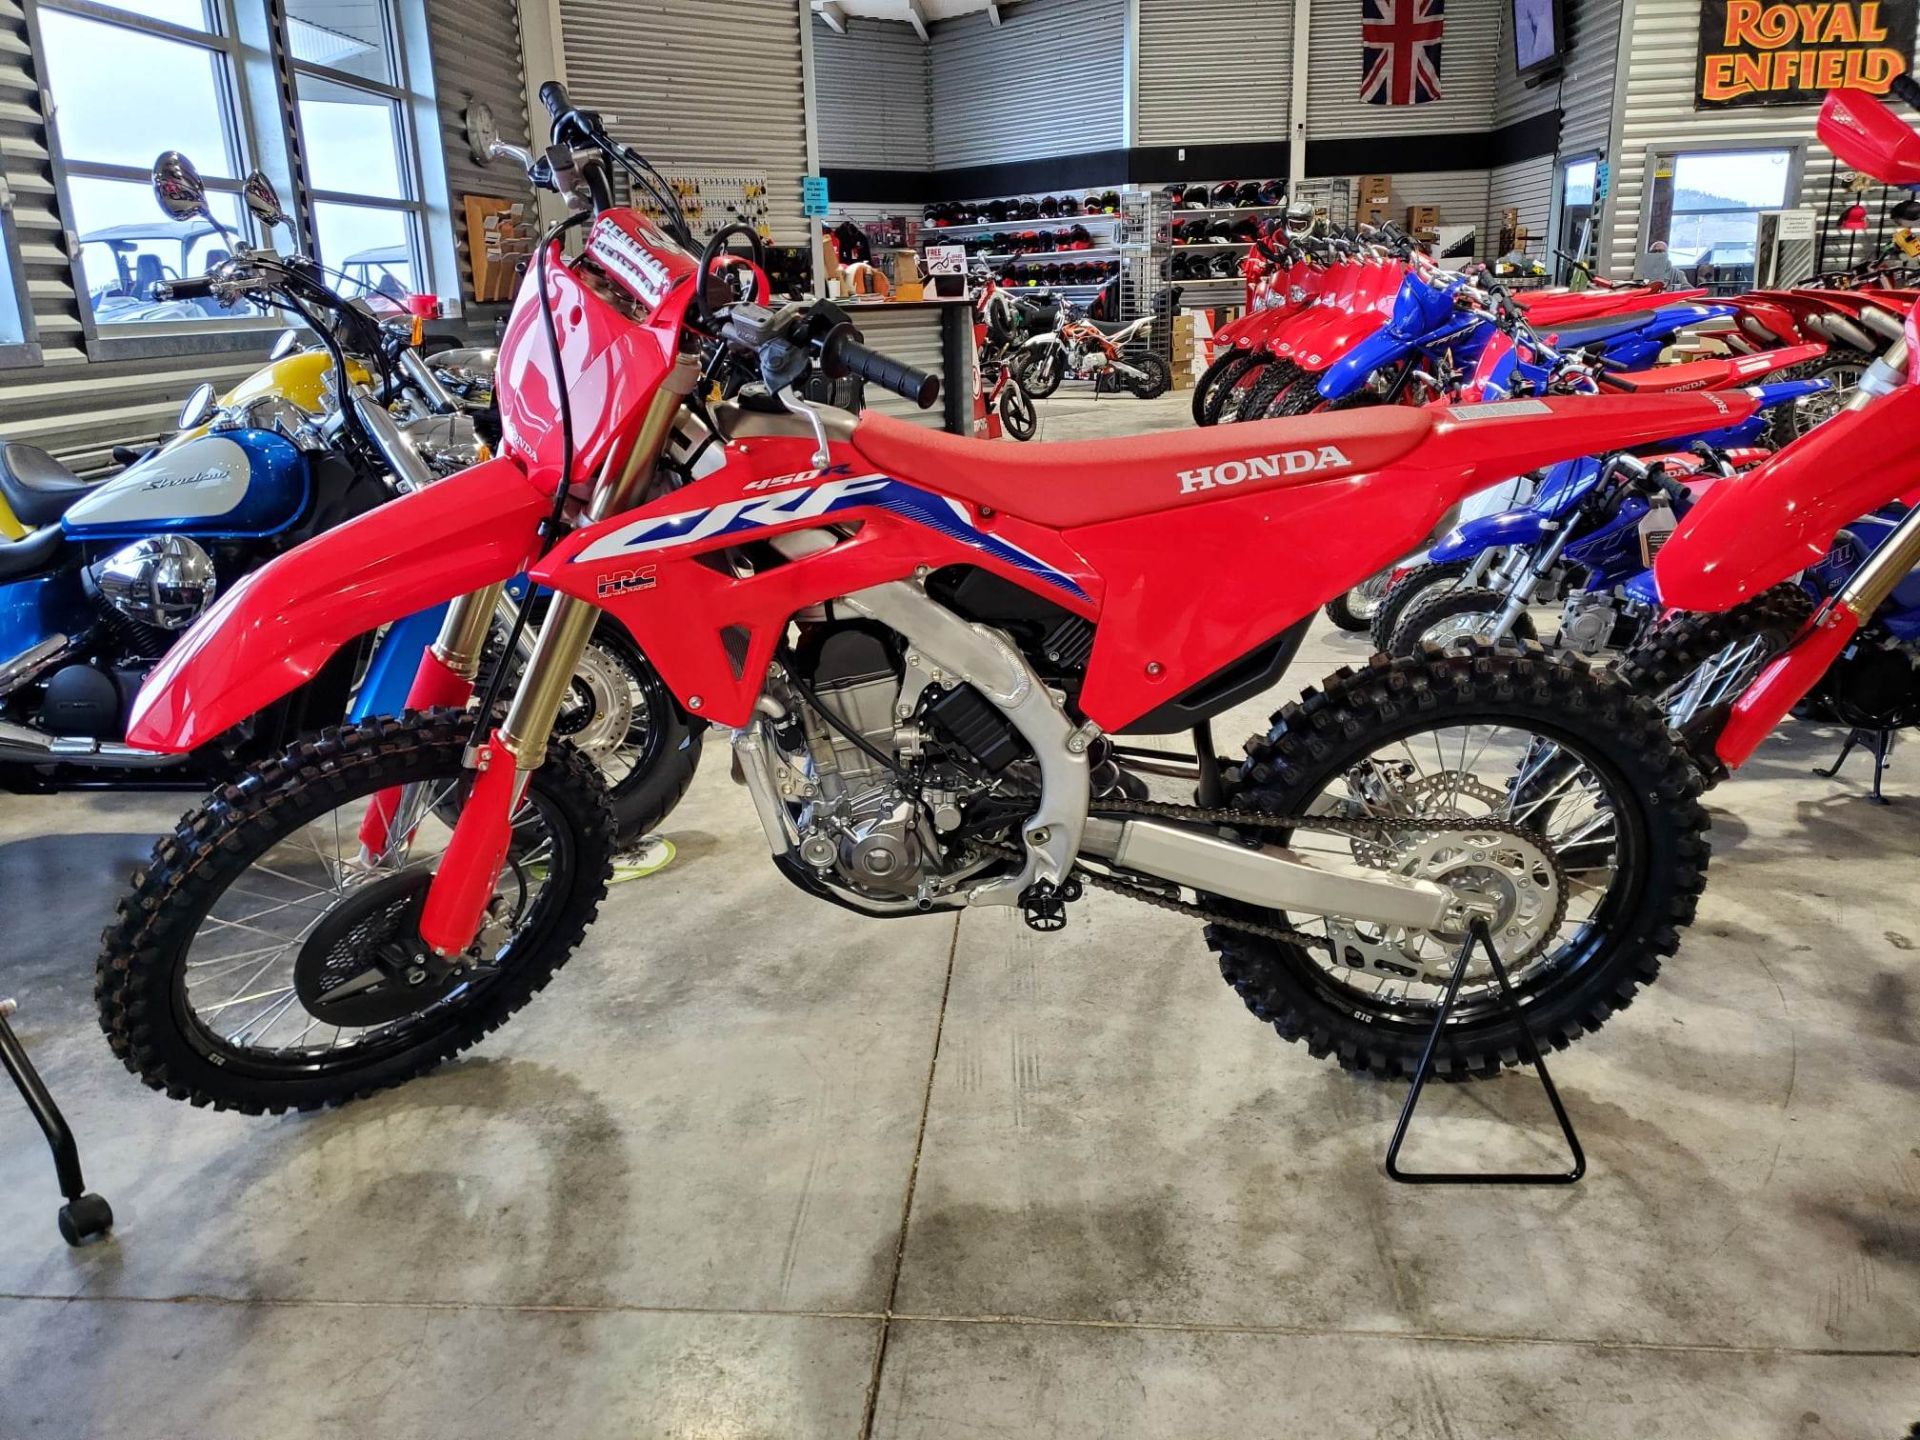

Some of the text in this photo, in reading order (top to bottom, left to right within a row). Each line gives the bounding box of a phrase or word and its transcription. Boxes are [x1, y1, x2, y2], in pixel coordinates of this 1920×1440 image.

[1723, 0, 1888, 49] ROYAL
[1702, 48, 1906, 101] ENFIELD
[1664, 380, 1707, 395] HONDA
[742, 463, 850, 491] 450R
[1176, 445, 1352, 495] HONDA
[574, 473, 893, 563] CRF
[597, 563, 657, 595] HRC
